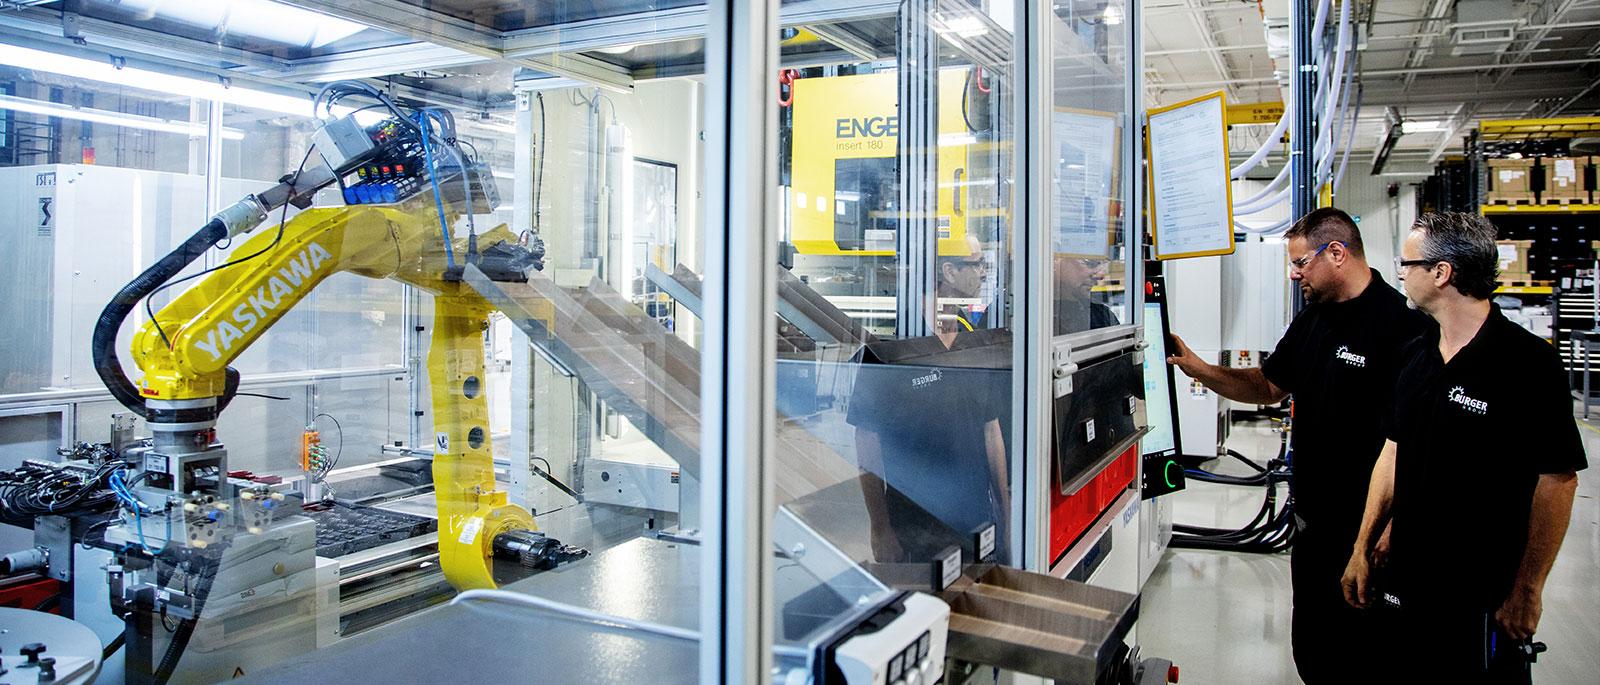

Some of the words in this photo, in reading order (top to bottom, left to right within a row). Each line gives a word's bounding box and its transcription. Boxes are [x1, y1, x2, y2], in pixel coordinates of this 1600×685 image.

[867, 141, 883, 150] 180
[195, 242, 332, 359] YASKAWA
[1340, 352, 1366, 364] BURGER
[1454, 393, 1488, 411] BURGER
